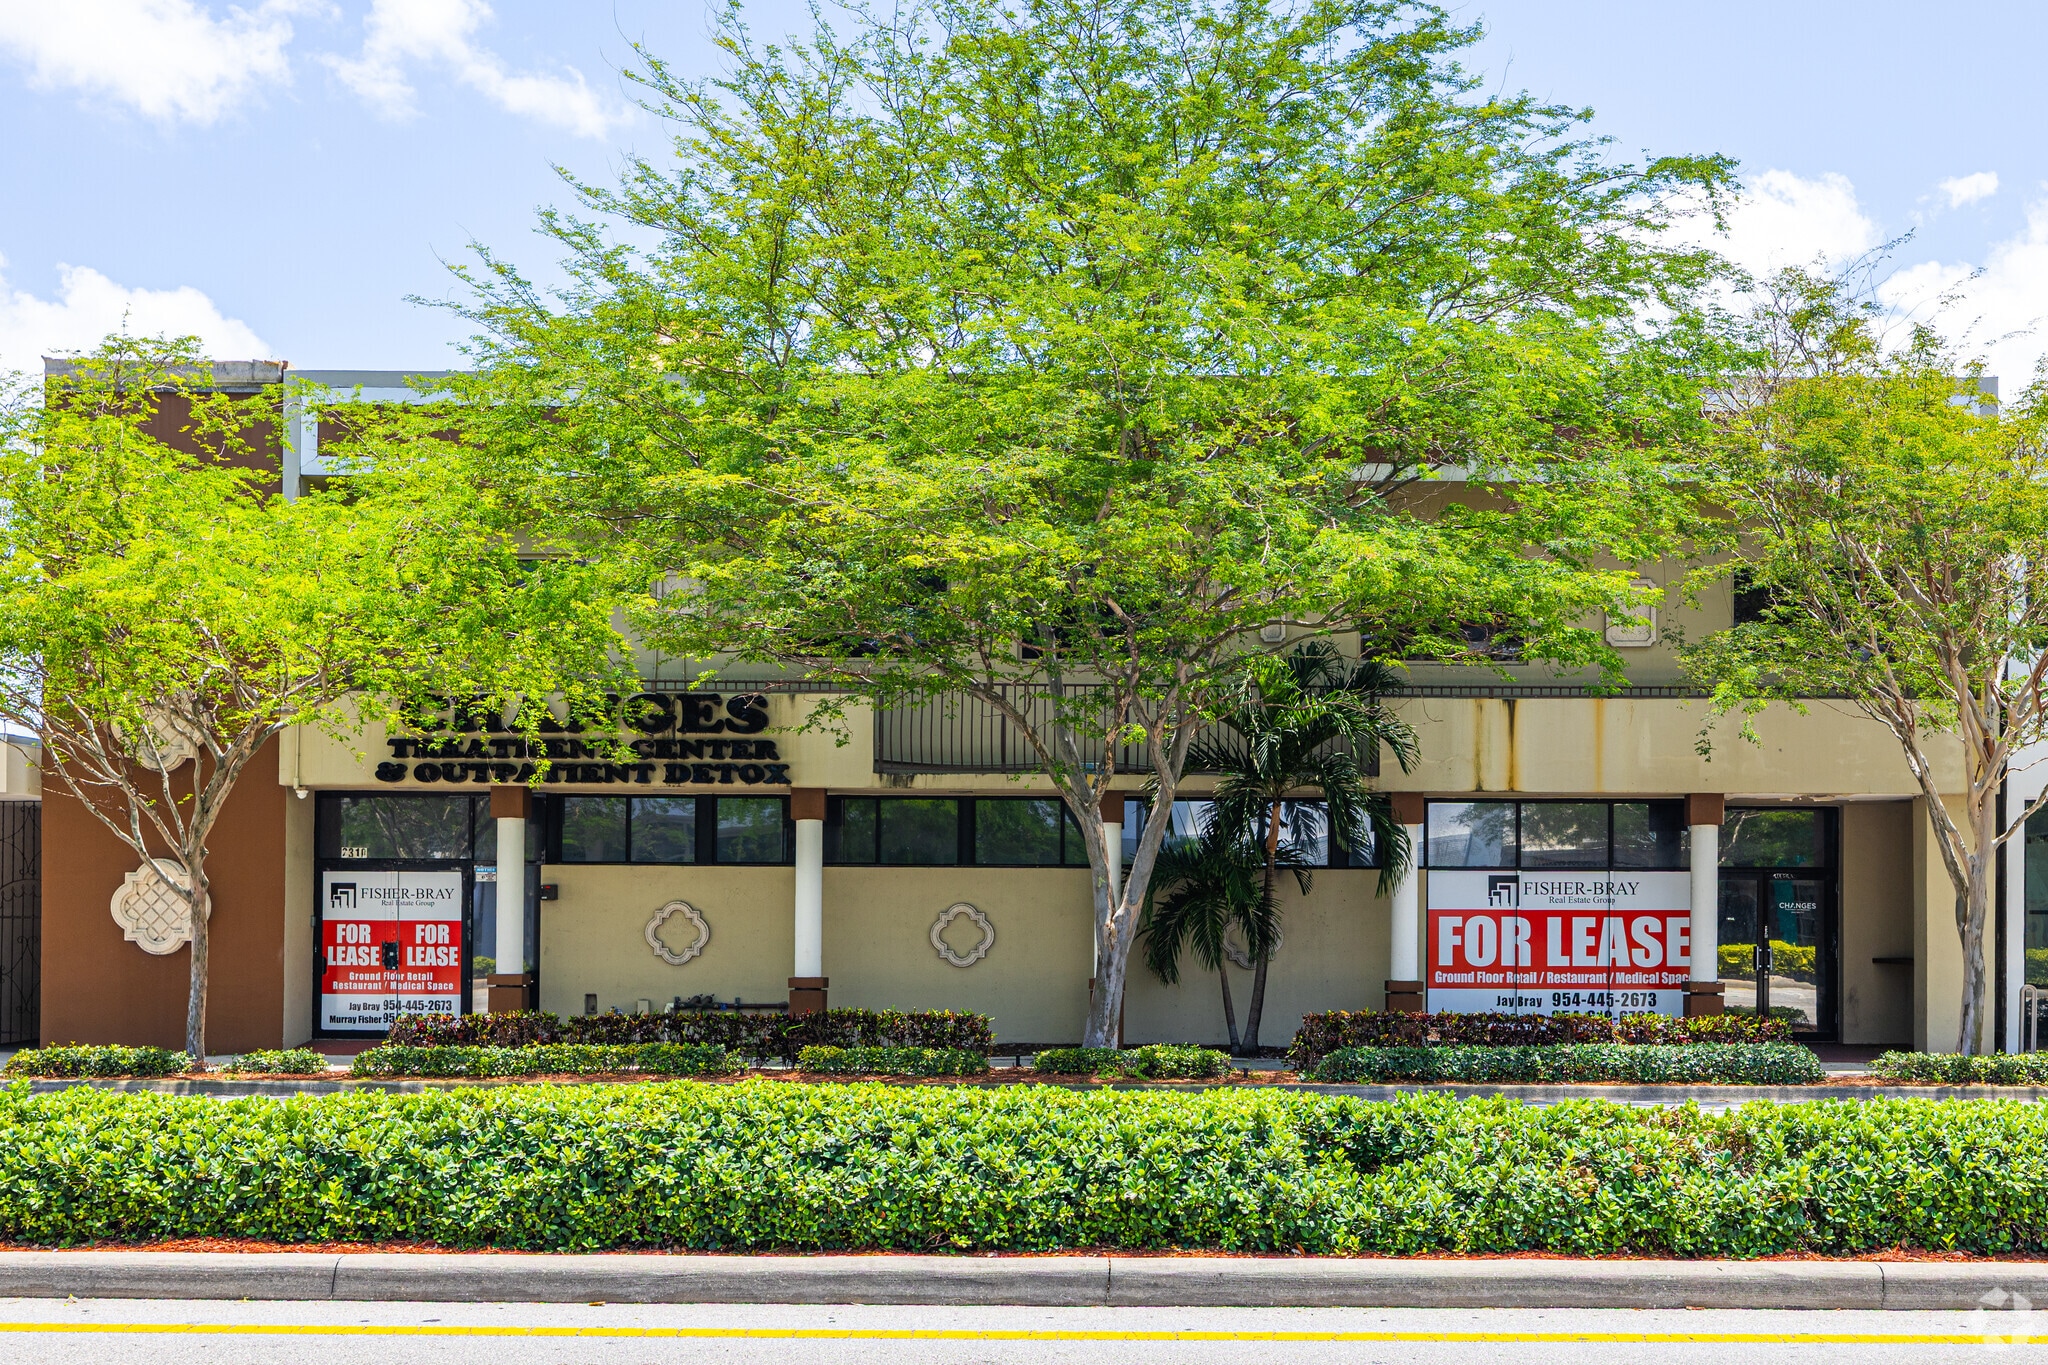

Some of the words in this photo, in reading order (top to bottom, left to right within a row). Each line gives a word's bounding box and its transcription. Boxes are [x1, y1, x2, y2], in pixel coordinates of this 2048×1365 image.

[629, 739, 781, 760] CENTER
[374, 761, 409, 783] &
[413, 762, 656, 784] OUTPATIENT
[664, 764, 792, 785] DETOX
[361, 888, 455, 900] FISHER-BRAY
[1523, 881, 1640, 896] FISHER-BRAY
[415, 900, 436, 908] Group
[1549, 896, 1566, 904] Real
[1568, 896, 1591, 904] Estate
[1592, 896, 1616, 906] Group
[336, 924, 371, 944] FOR
[415, 924, 450, 944] FOR
[1438, 915, 1531, 967] FOR
[1547, 915, 1690, 968] LEASE
[327, 946, 380, 966] LEASE
[407, 946, 459, 967] LEASE
[349, 972, 381, 981] Ground
[383, 972, 404, 981] Floor
[406, 972, 434, 981] Retail
[1435, 971, 1475, 983] Ground
[1477, 971, 1504, 983] Floor
[1506, 971, 1537, 984] Retail
[1539, 972, 1545, 984] /
[1546, 972, 1607, 984] Restaurant
[1609, 972, 1614, 984] /
[1616, 972, 1660, 984] Medical
[1661, 972, 1690, 985] Spac
[332, 981, 382, 990] Restaurant
[383, 981, 388, 990] /
[390, 982, 425, 990] Medical
[427, 982, 454, 991] Space
[349, 1002, 362, 1011] Jay
[362, 1002, 380, 1011] Bray
[383, 1000, 453, 1011] 954-445-2673
[1496, 996, 1515, 1007] Jay
[1517, 996, 1543, 1007] Bray
[1552, 992, 1657, 1007] 954-445-2673
[329, 1015, 357, 1024] Murray
[358, 1015, 382, 1024] Fisher
